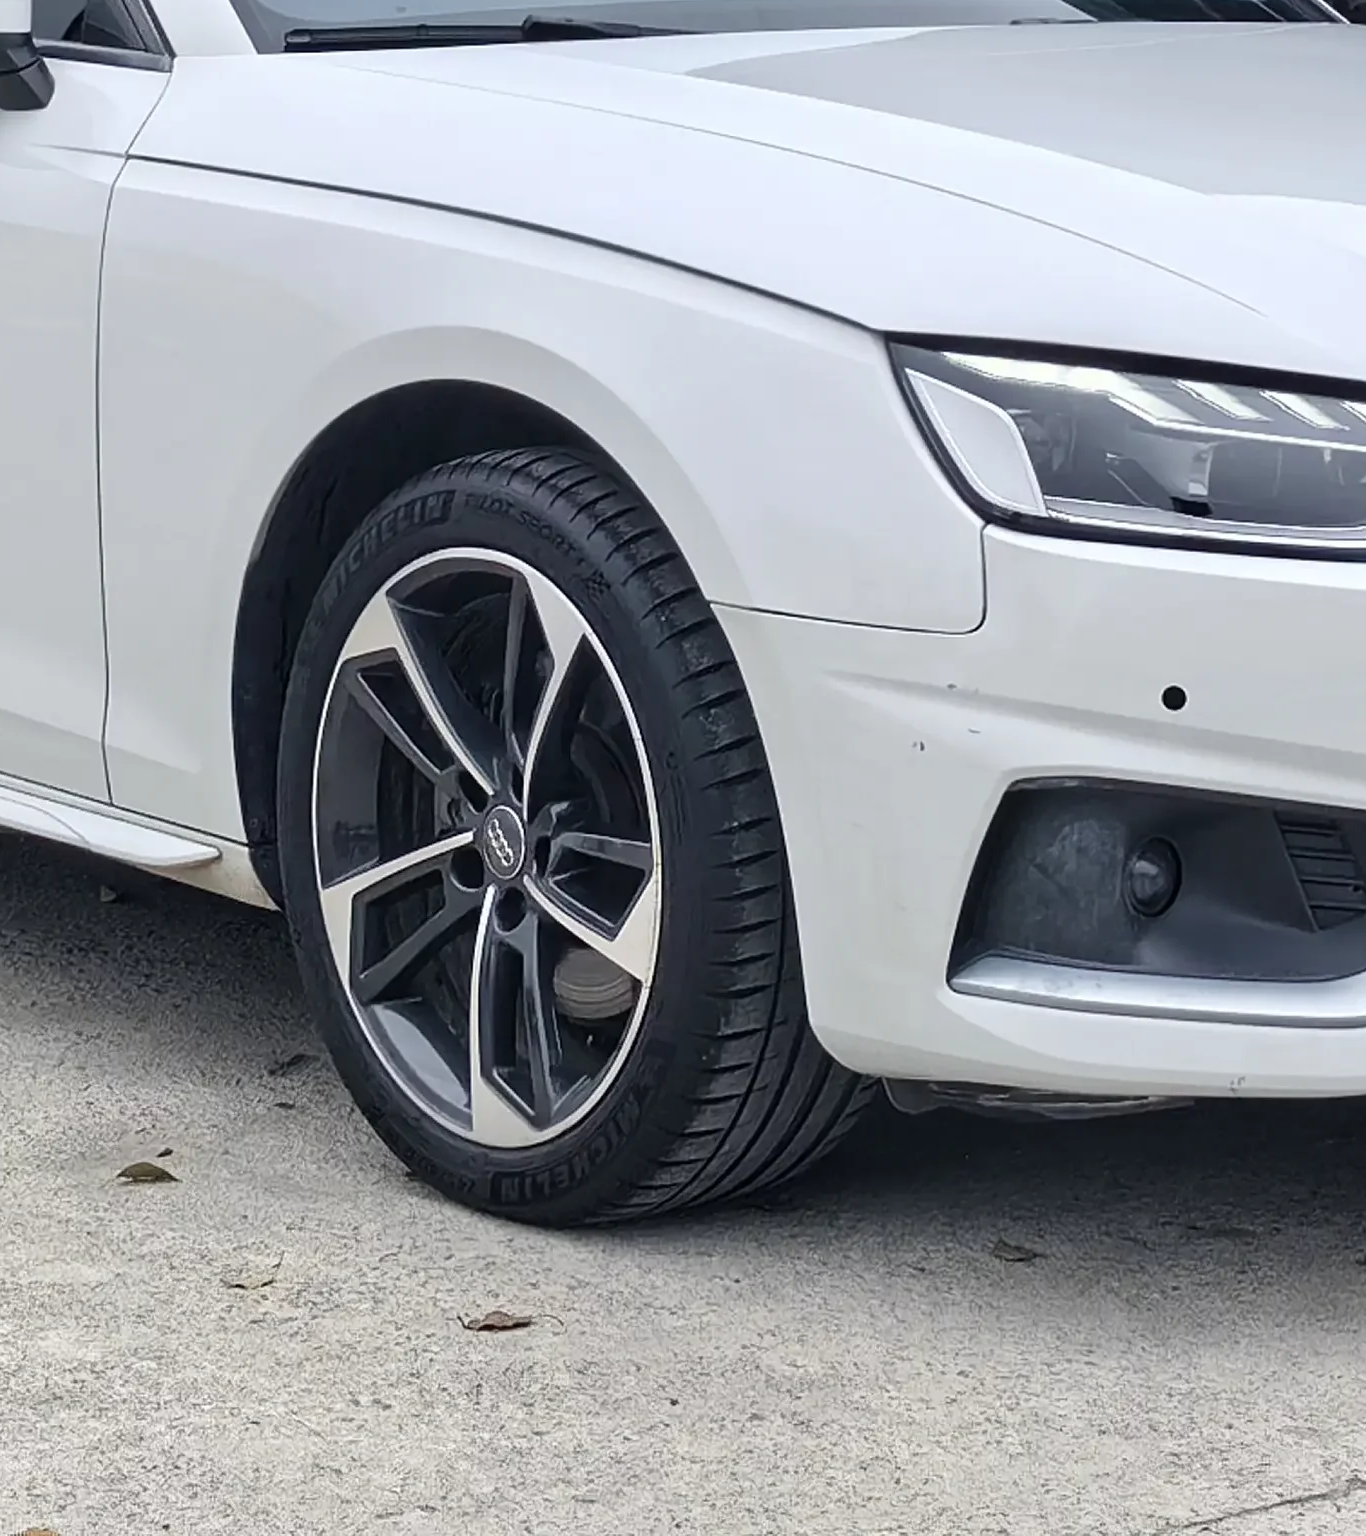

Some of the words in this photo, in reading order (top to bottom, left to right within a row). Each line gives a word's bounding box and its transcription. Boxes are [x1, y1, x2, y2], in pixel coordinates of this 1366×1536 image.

[321, 488, 453, 617] MICHELIN
[464, 492, 516, 515] PILOT
[517, 509, 578, 558] SPORT
[500, 1089, 642, 1203] MICHELIN
